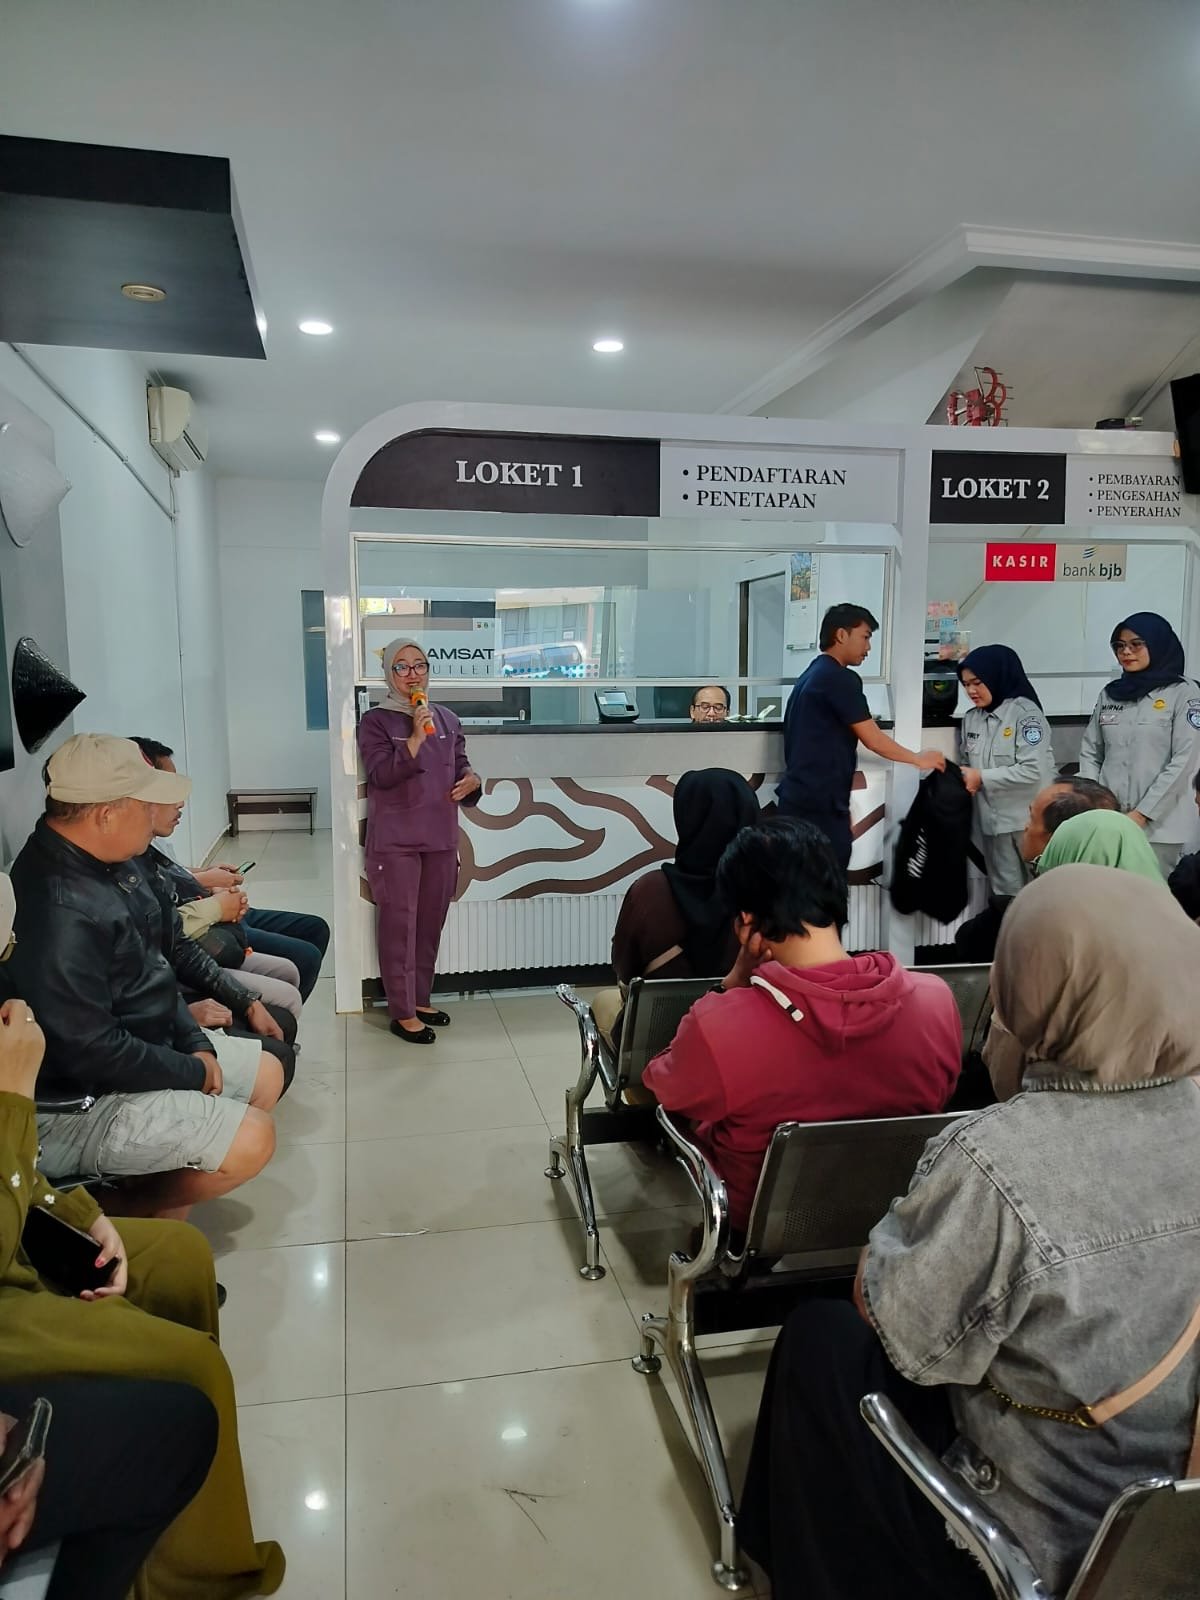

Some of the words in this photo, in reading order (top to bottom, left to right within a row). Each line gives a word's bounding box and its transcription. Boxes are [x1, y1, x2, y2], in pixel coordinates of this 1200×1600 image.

[455, 460, 563, 486] LOKET
[571, 465, 583, 487] 1
[696, 465, 847, 485] PENDAFTARAN
[1097, 473, 1181, 486] PEMBAYARAN
[941, 477, 1031, 499] LOKET
[1037, 479, 1050, 500] 2
[696, 490, 816, 508] PENETAPAN
[1097, 490, 1181, 502] PENGESAHAN
[1096, 506, 1181, 518] PENYERAHAN
[992, 555, 1049, 568] KASIR
[1063, 563, 1096, 577] bank
[1099, 563, 1122, 580] bjb
[427, 648, 495, 660] AMSAT
[432, 664, 490, 675] UTLET
